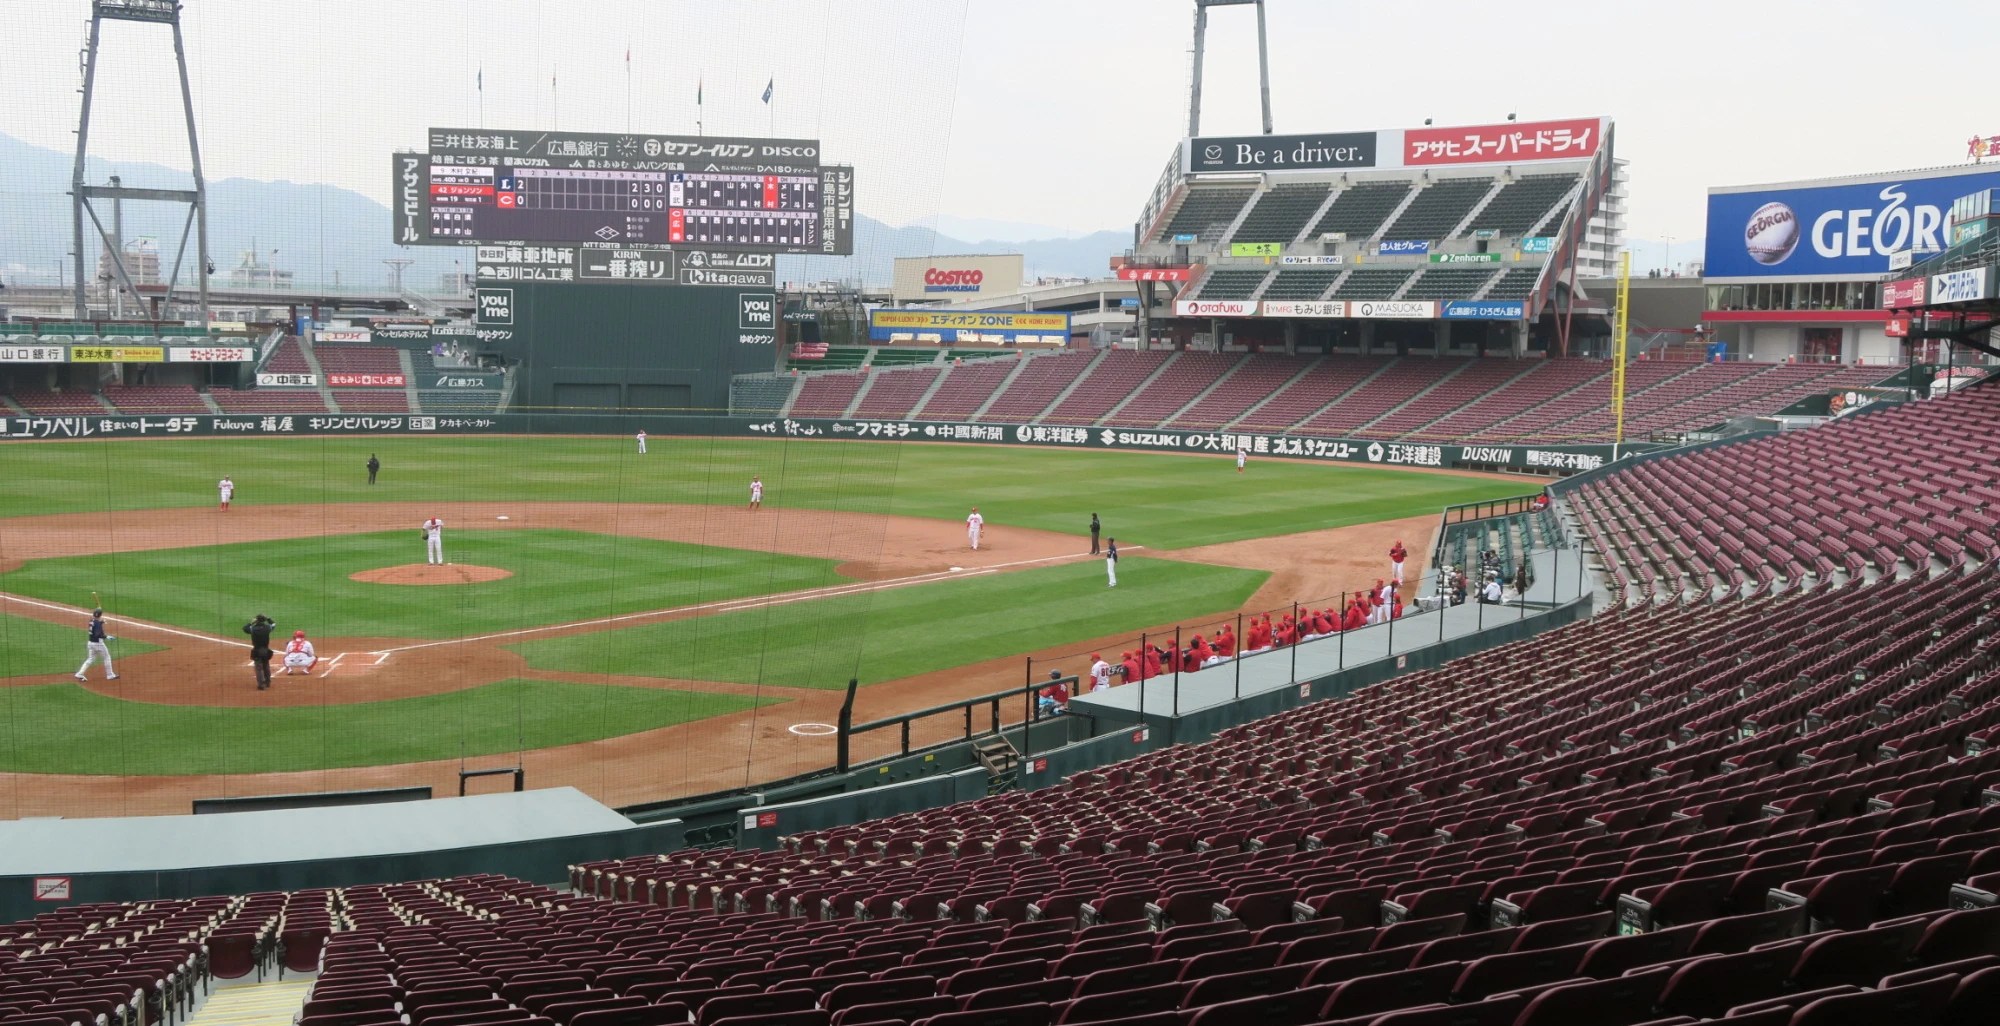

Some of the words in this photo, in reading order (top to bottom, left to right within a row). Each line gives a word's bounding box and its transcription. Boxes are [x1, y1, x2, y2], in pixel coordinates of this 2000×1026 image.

[431, 134, 519, 150] 三井住友海上
[547, 140, 609, 157] 広島銀行
[1412, 140, 1460, 158] アサヒ
[1464, 128, 1591, 157] スーパードライ
[762, 146, 817, 157] DISCO
[1236, 144, 1266, 165] Be
[1274, 149, 1285, 164] a
[1293, 141, 1364, 164] driver.
[633, 161, 685, 171] JAバンク広島
[517, 180, 523, 189] 2
[632, 183, 638, 192] 2
[644, 183, 650, 193] 3
[656, 184, 662, 193] 0
[402, 158, 419, 242] アサヒビール
[727, 182, 734, 207] 山川
[753, 183, 761, 208] 中村
[767, 183, 774, 208] 木村
[517, 195, 523, 205] 0
[631, 198, 637, 208] 0
[644, 199, 650, 208] 0
[656, 200, 662, 209] 0
[822, 172, 835, 252] 広島市信用組合
[1811, 184, 1954, 258] GEOR
[1380, 241, 1429, 250] 合人社グループ
[480, 249, 504, 258] 春日野
[506, 247, 574, 264] 東亜地所
[613, 251, 641, 260] KIRIN
[736, 253, 772, 267] ムロオ
[1449, 254, 1491, 262] Zenhoren
[497, 266, 574, 281] 西川ゴム工業
[590, 259, 664, 277] 一番搾り
[480, 295, 507, 308] you
[744, 301, 769, 312] you
[1375, 303, 1423, 312] MASUOKA
[486, 308, 509, 317] me
[1294, 304, 1342, 315] もみじ銀行
[749, 312, 771, 322] me
[930, 315, 976, 325] エディオン
[979, 315, 1013, 326] ZONE
[376, 329, 428, 339] ベッセルホテルズ
[739, 334, 774, 344] ゆめタウン
[1, 349, 59, 360] 山口銀行
[75, 349, 112, 360] 東洋水産
[276, 375, 313, 385] 中電工
[448, 378, 484, 387] 広島ガス
[213, 419, 253, 430] Fukuya
[309, 417, 402, 430] キリンビバレッジ
[439, 419, 496, 428] タカキベーカリー
[856, 422, 919, 437] フマキラー
[1033, 427, 1088, 444] 東洋証券
[1119, 432, 1180, 446] SUZUKI
[1387, 444, 1442, 466] 五洋建設
[1461, 446, 1512, 463] DUSKIN
